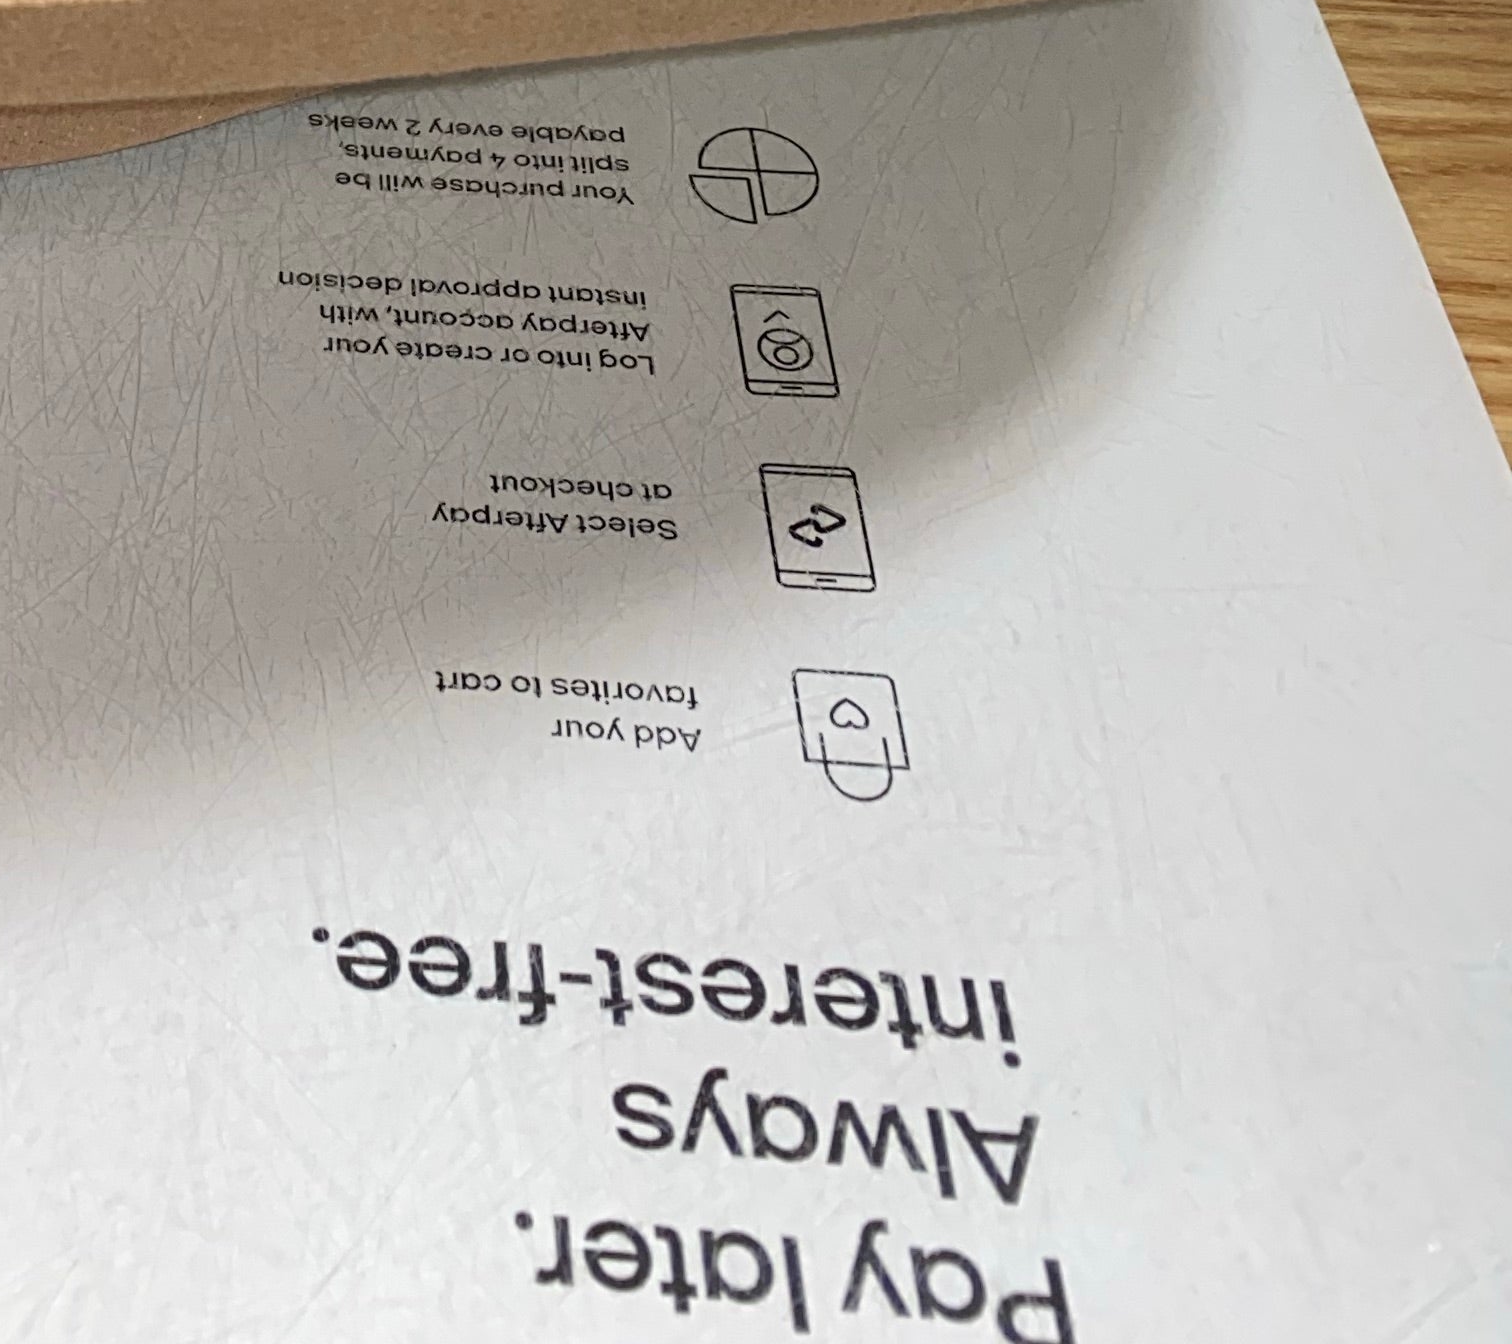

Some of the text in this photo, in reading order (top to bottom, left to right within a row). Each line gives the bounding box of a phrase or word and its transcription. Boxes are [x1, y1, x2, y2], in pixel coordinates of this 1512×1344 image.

[308, 113, 625, 143] payable every 2 weeks
[338, 143, 629, 174] split into 4 payments,
[335, 173, 634, 205] Your purchase will be
[278, 271, 646, 310] instant approval decision
[320, 305, 650, 341] Afterpay account, with
[323, 336, 655, 375] Log into or create your
[489, 473, 672, 502] at checkout
[431, 502, 678, 540] Select Afterpay
[434, 670, 699, 710] favorites to cart
[551, 716, 701, 752] Add your
[311, 927, 1022, 1068] interest-free.
[611, 1068, 1040, 1206] Always
[514, 1212, 1077, 1344] Pay later.
